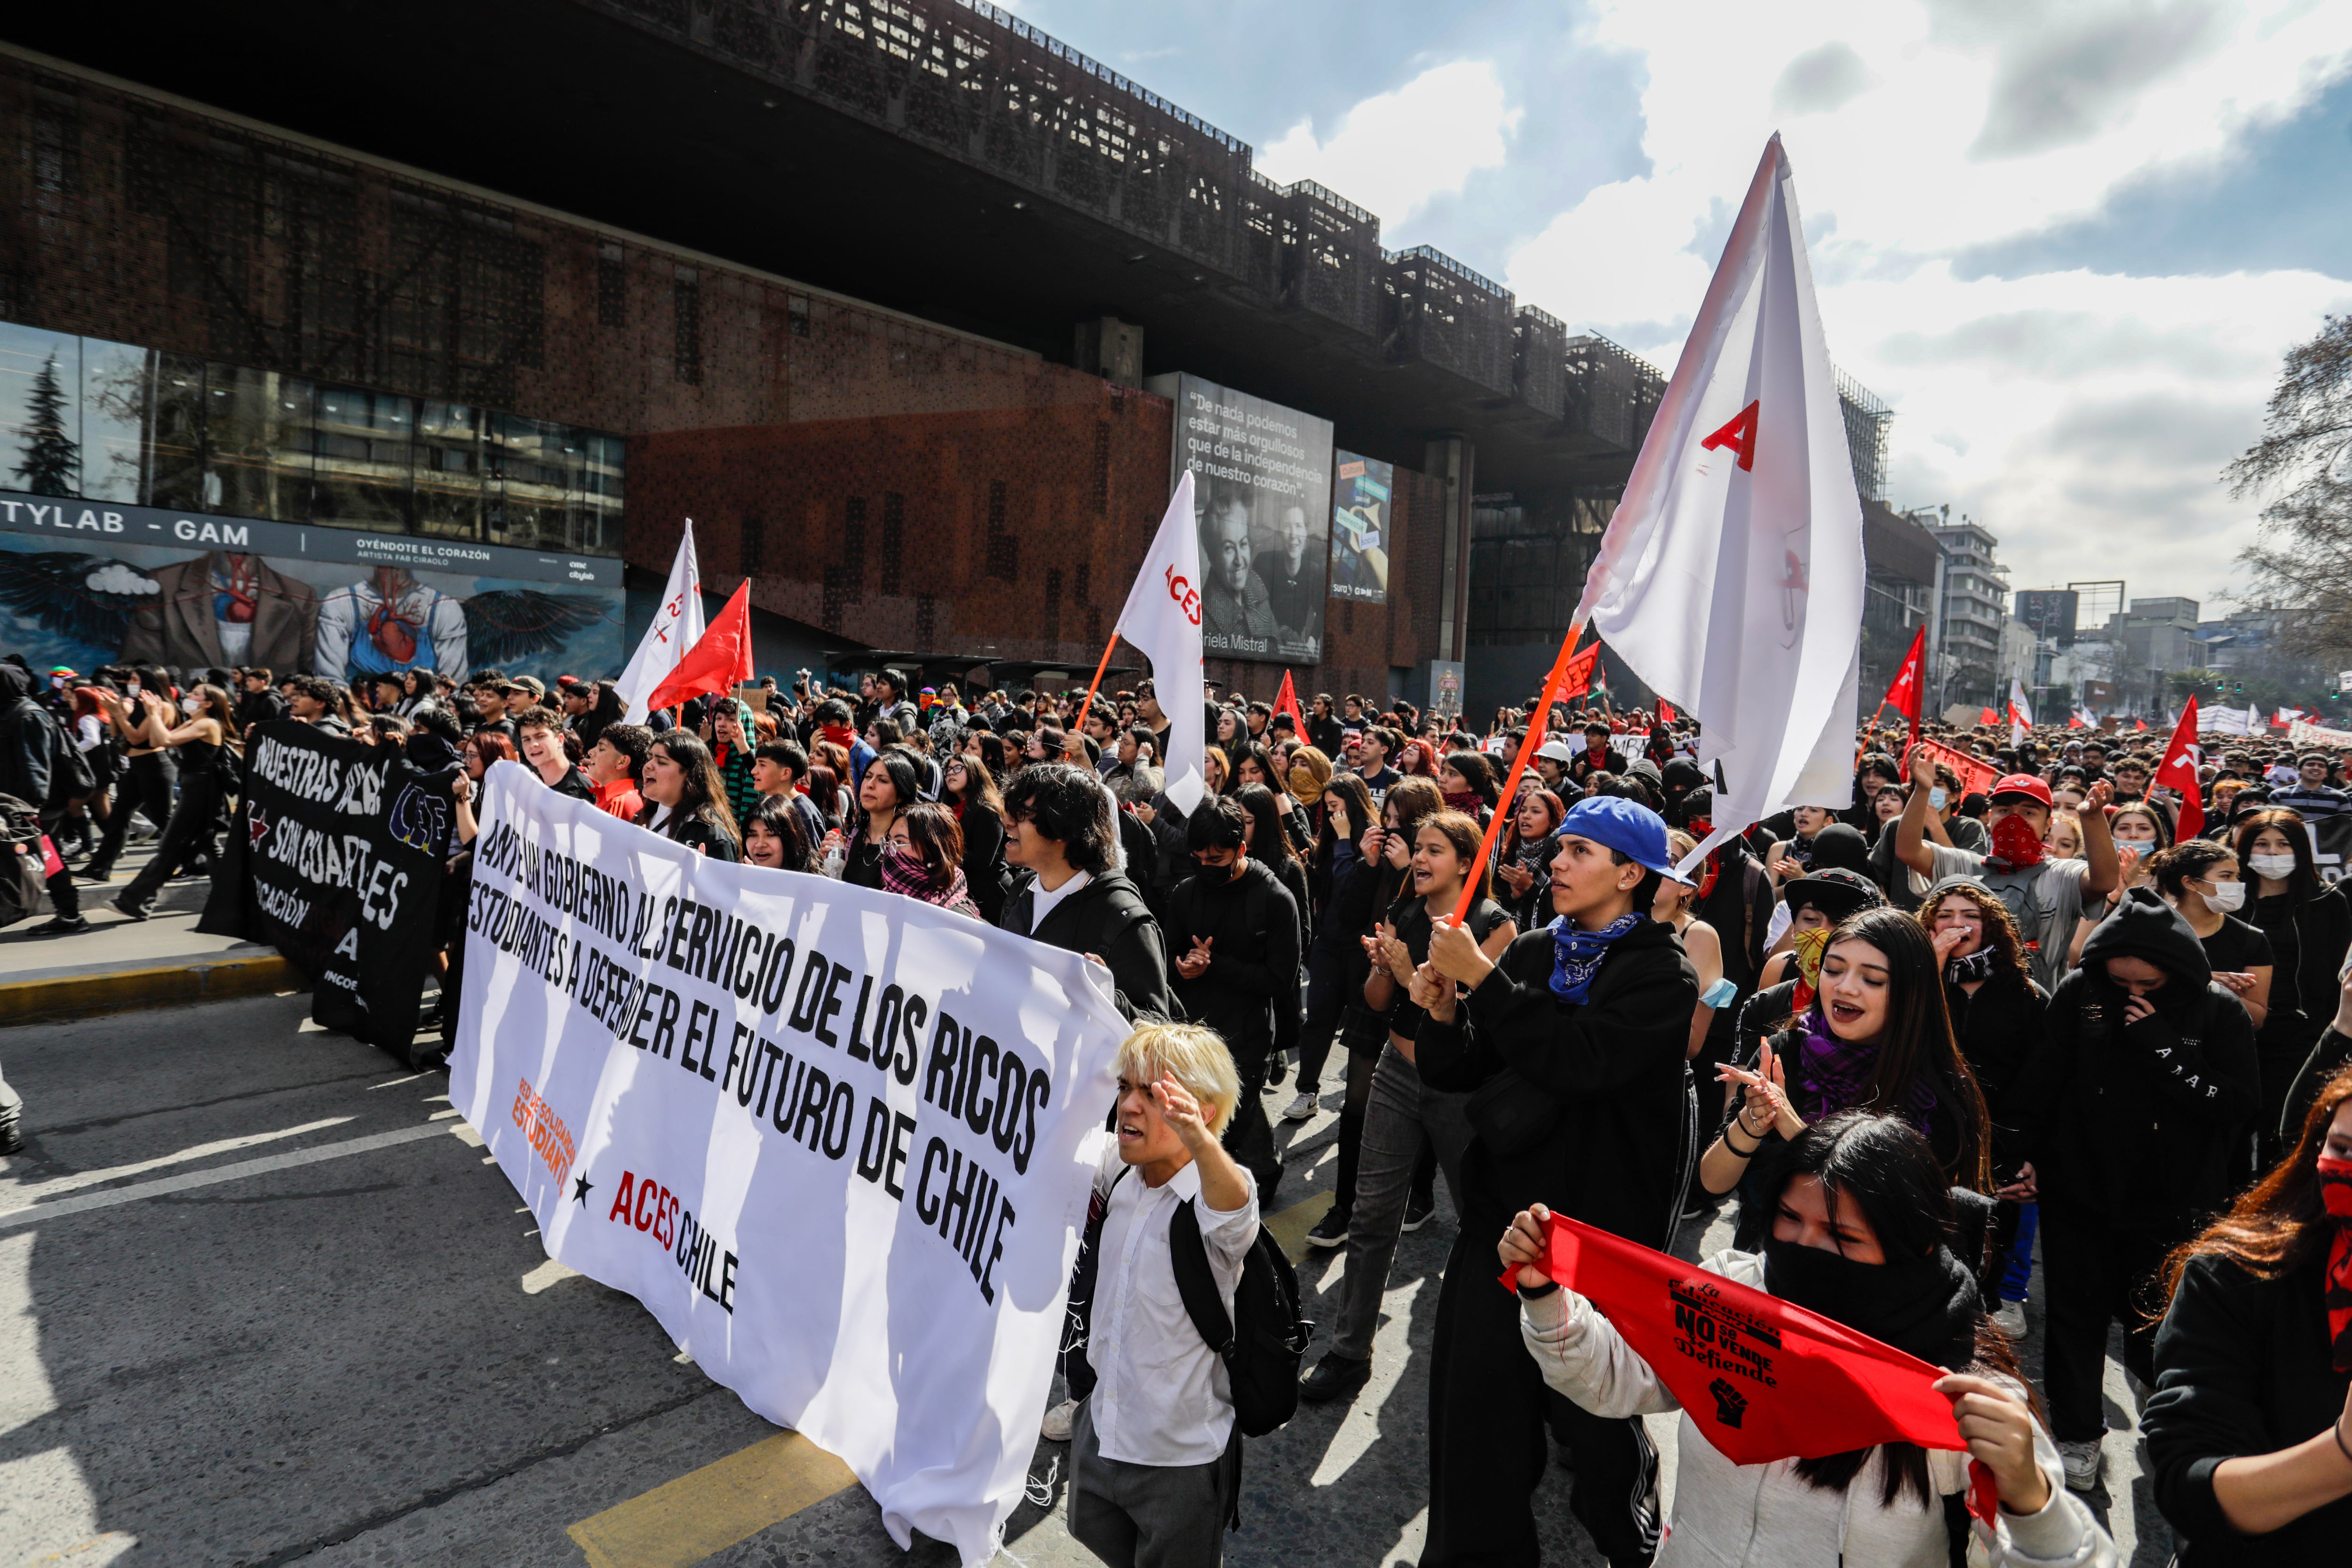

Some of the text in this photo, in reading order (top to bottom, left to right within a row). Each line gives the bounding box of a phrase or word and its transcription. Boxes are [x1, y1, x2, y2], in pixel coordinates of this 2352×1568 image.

[1189, 417, 1305, 460] estar más orgullosos
[1215, 403, 1245, 422] nada
[1247, 414, 1297, 438] podemos
[1187, 454, 1203, 471] de
[1206, 462, 1251, 484] nuestro
[1188, 437, 1322, 484] que de la independencia
[0, 501, 125, 533] TYLAB
[175, 520, 249, 546] GAM
[357, 539, 490, 560] OYÉNDOTE EL CORAZÓN
[357, 550, 449, 566] ARTISTA FAB CIRAOLO
[569, 571, 595, 581] citylab
[1165, 564, 1202, 625] ACES
[1231, 634, 1267, 653] Mistral
[253, 735, 340, 803] NUESTRAS
[268, 816, 302, 868] SON
[479, 819, 1051, 1176] ANTE UN GOBIERNO AL SERVICIO DE LOS RICOS
[467, 879, 567, 987] ESTUDIANTES
[565, 939, 581, 999] A
[579, 947, 681, 1060] DEFENDER
[680, 1000, 719, 1083] EL
[722, 1020, 854, 1160] FUTURO
[857, 1097, 917, 1202] DE
[916, 1137, 1016, 1307] CHILE
[519, 1077, 532, 1101] RED
[530, 1091, 541, 1114] DE
[609, 1170, 739, 1316] ACES CHILE
[1698, 1282, 1720, 1298] La
[1675, 1303, 1738, 1343] NO se
[1674, 1337, 1778, 1389] Defiende
[1718, 1334, 1773, 1372] VENDE
